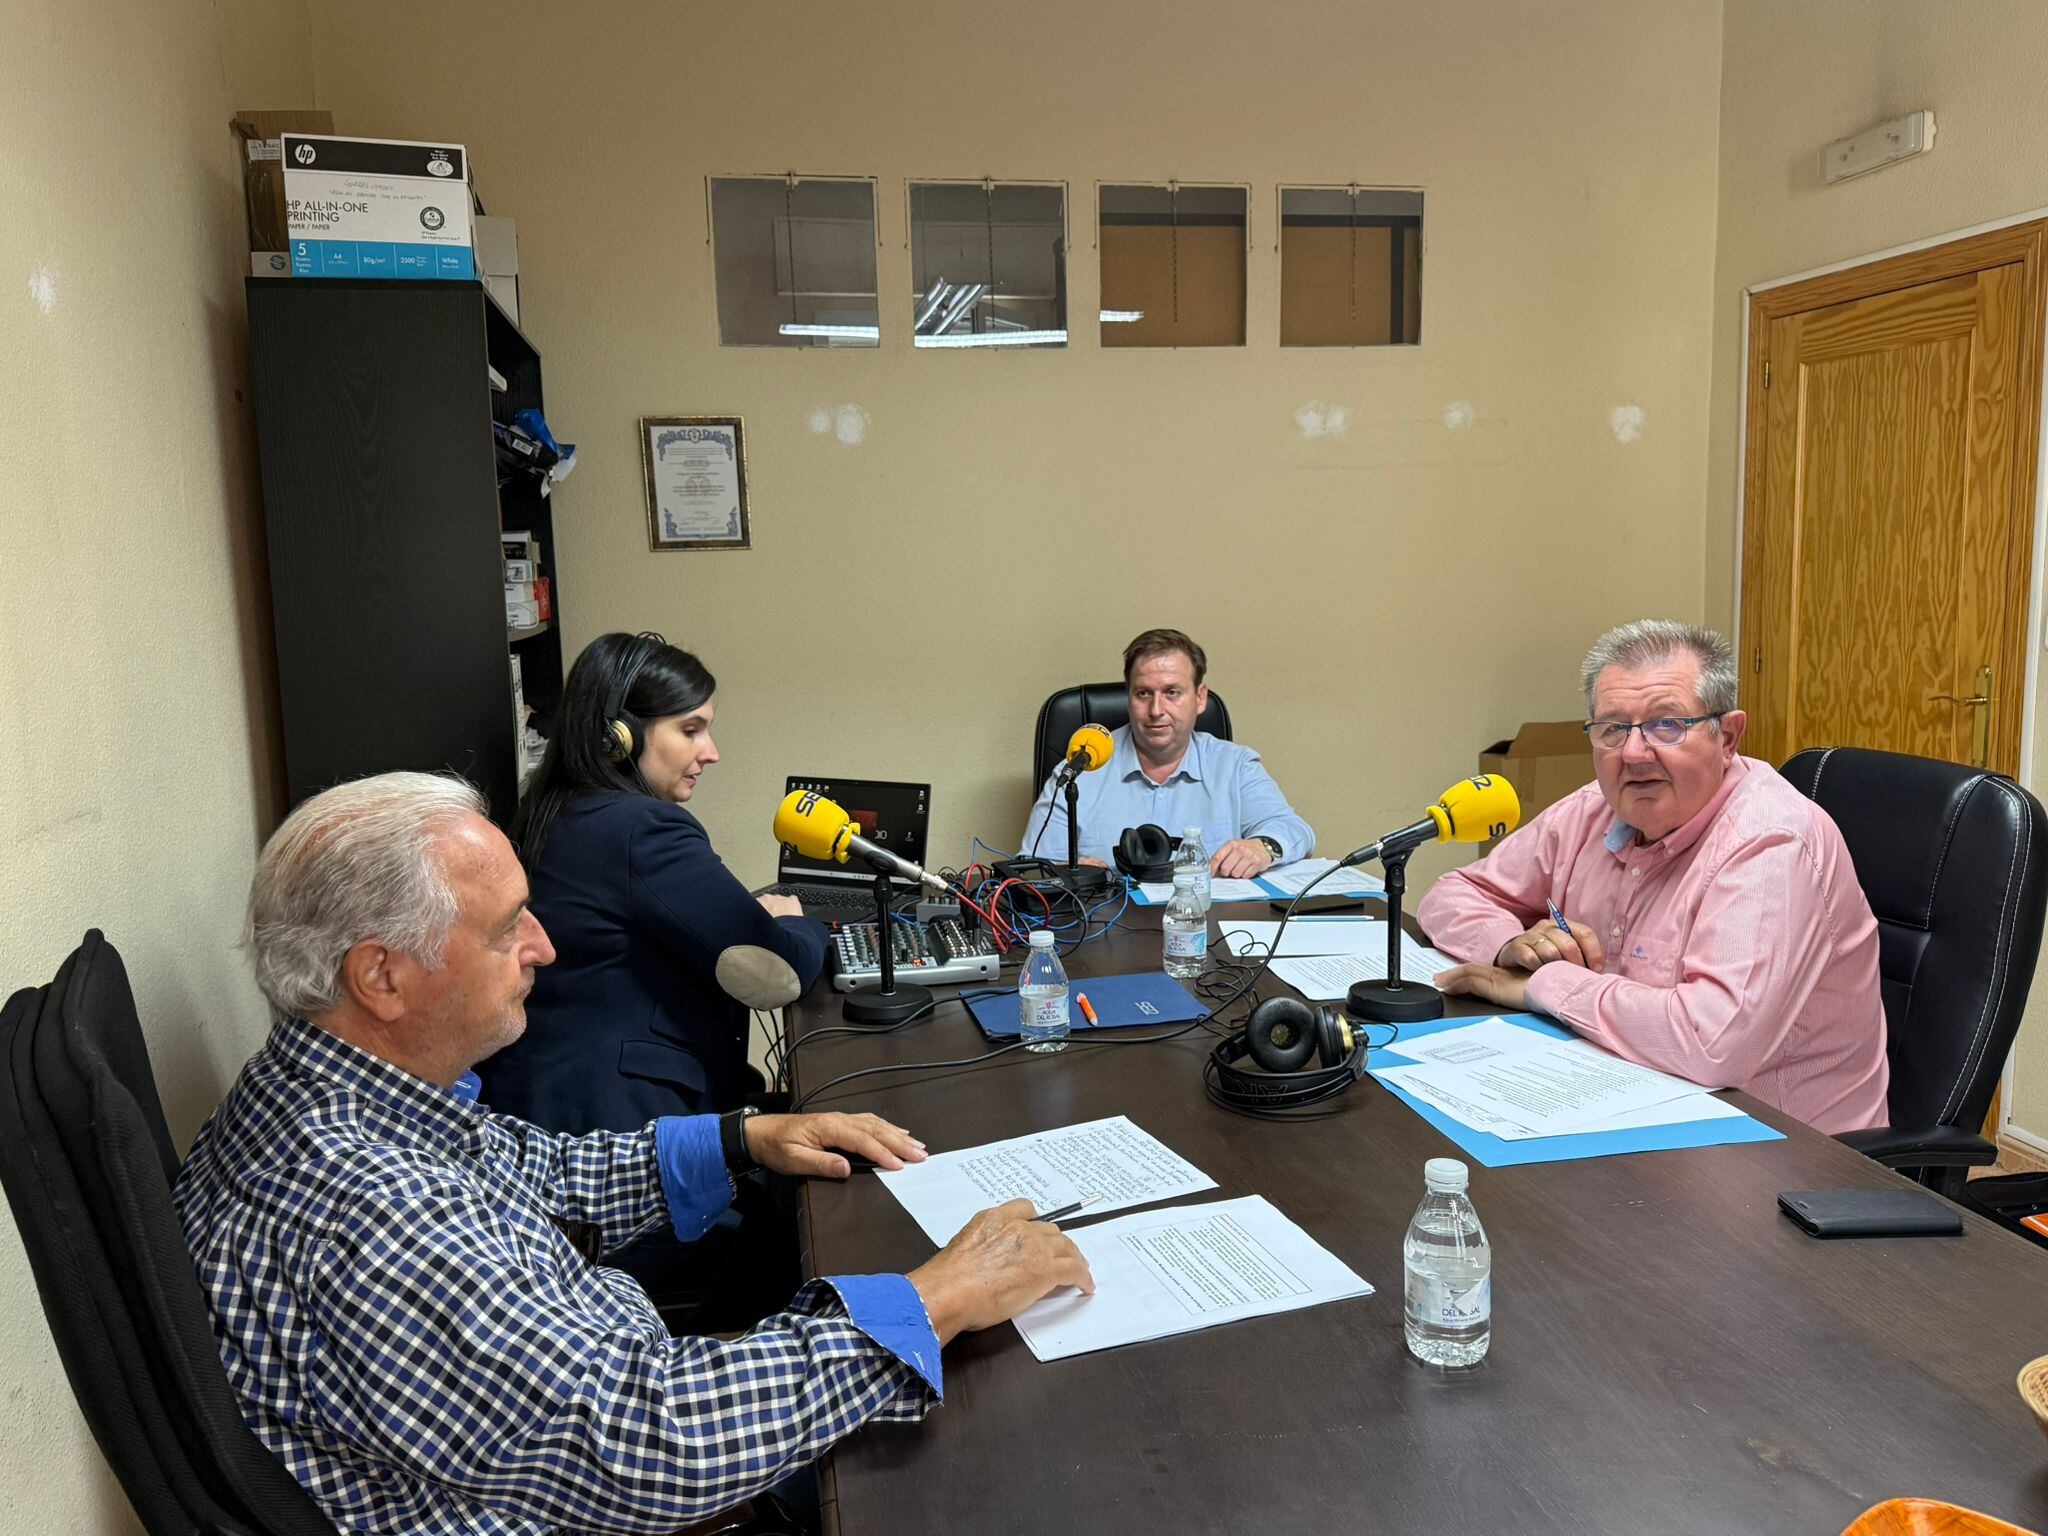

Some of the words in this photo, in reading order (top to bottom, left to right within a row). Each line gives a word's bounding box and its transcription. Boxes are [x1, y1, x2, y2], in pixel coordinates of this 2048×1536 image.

[286, 200, 300, 210] HP
[304, 201, 368, 213] ALL-IN-ONE
[287, 211, 340, 222] PRINTING
[297, 242, 307, 256] 5
[1442, 1308, 1457, 1317] DEL
